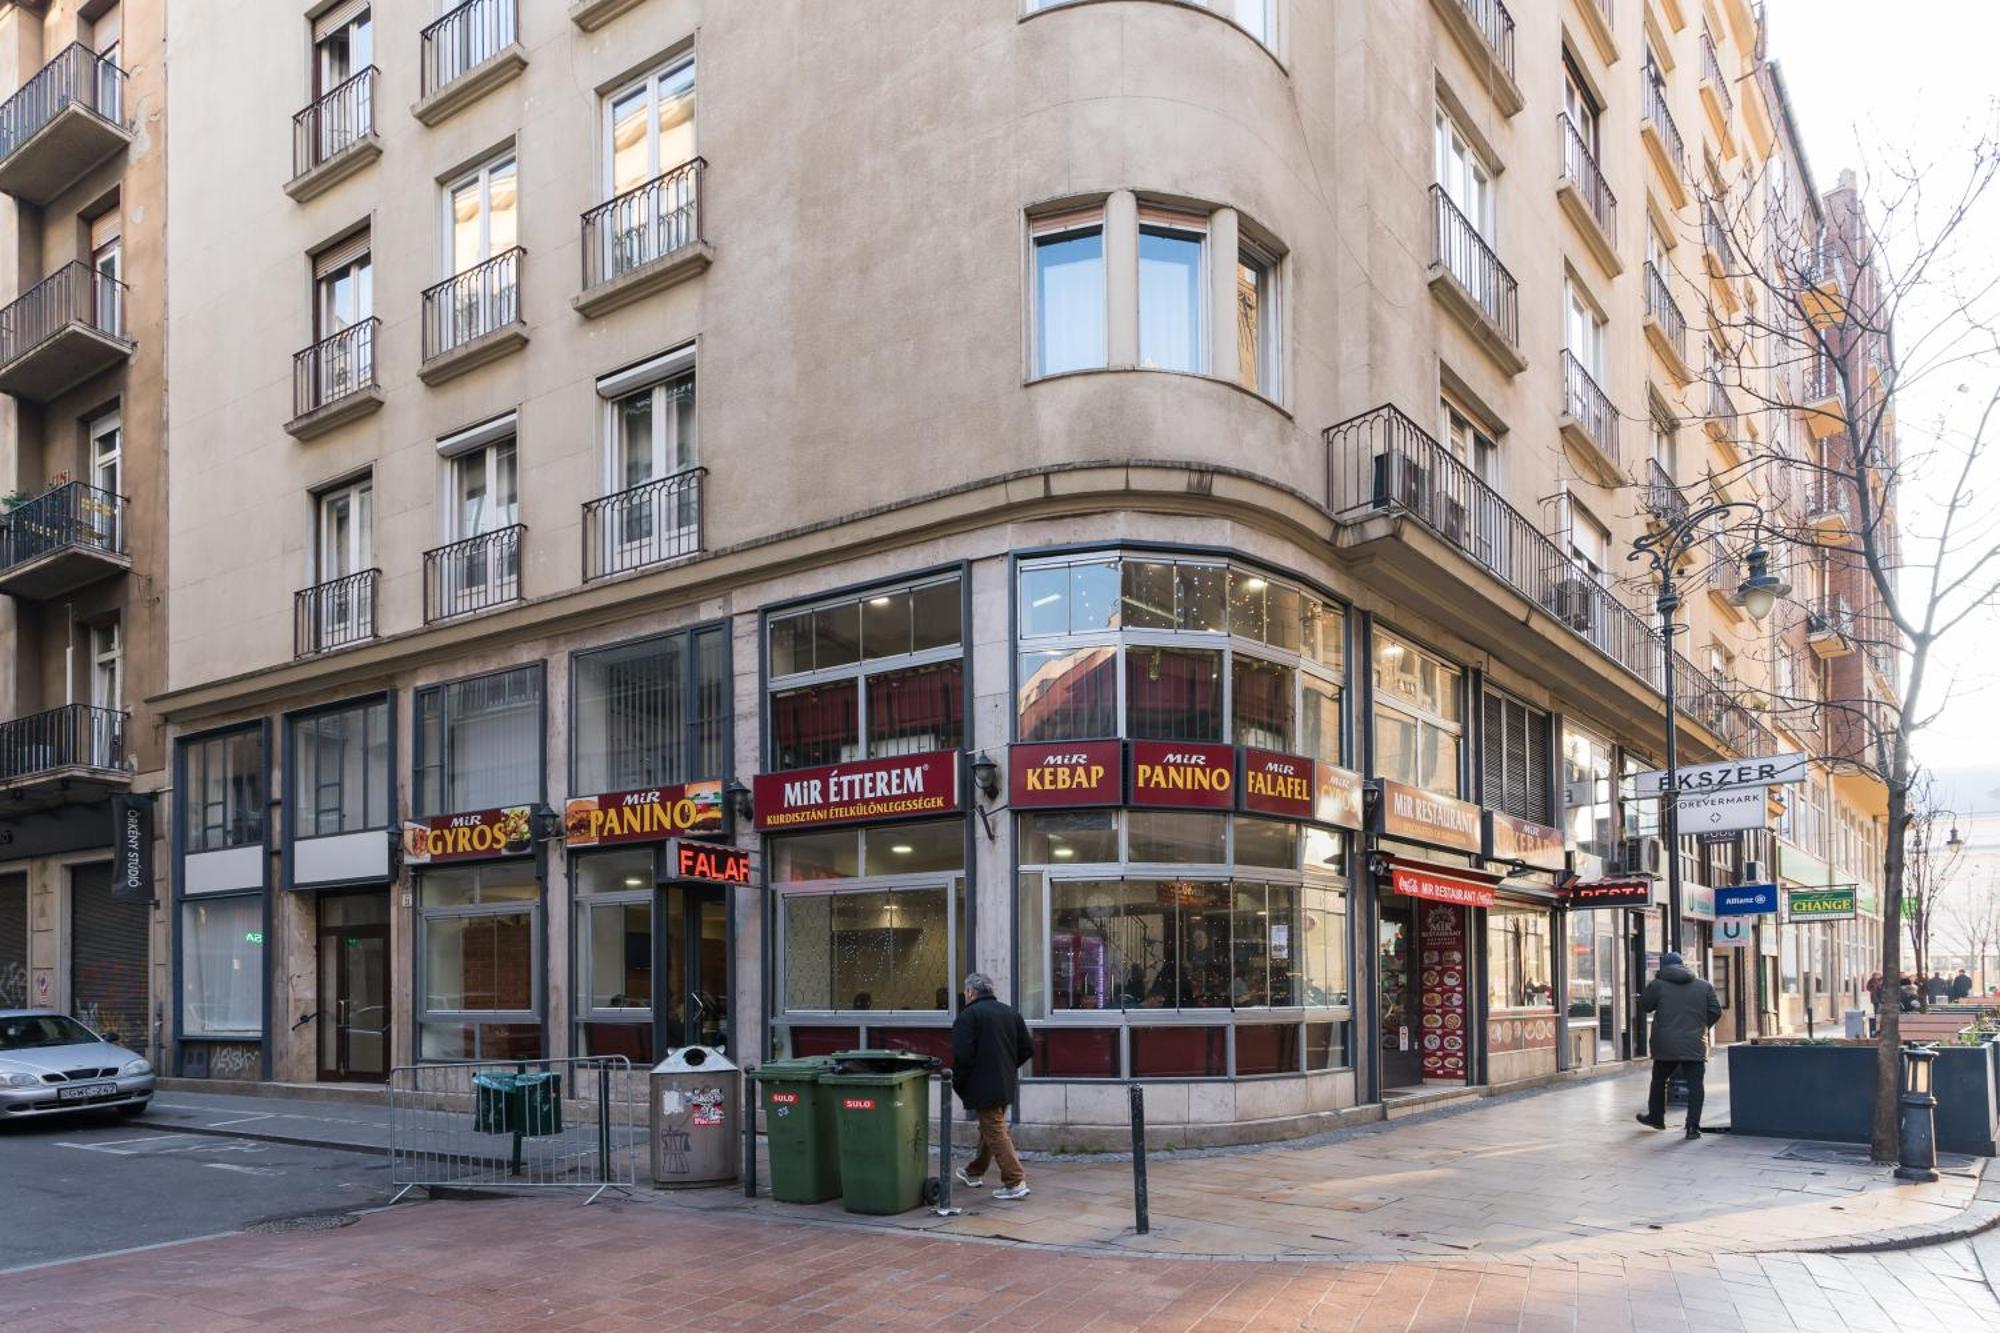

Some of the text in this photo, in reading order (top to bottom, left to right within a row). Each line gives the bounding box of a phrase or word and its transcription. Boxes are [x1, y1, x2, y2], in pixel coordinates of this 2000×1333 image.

[1026, 765, 1104, 790] KEBAP
[1137, 765, 1230, 791] PANINO
[1248, 771, 1310, 801] FALAFEL
[1659, 764, 1776, 791] ÉKSZER
[1679, 794, 1760, 809] OREVERMARK
[590, 799, 697, 838] PANINO
[767, 809, 827, 825] KURDISZTÁNI
[1416, 800, 1473, 833] RESTAURANT
[428, 822, 507, 855] GYROS
[128, 852, 142, 888] STÚDIÓ
[1435, 884, 1477, 902] RESTAURANT
[1726, 897, 1754, 905] Allianz
[1792, 899, 1851, 912] CHANGE
[1724, 922, 1740, 938] U
[773, 1094, 794, 1102] SULO
[846, 1100, 871, 1108] SULO
